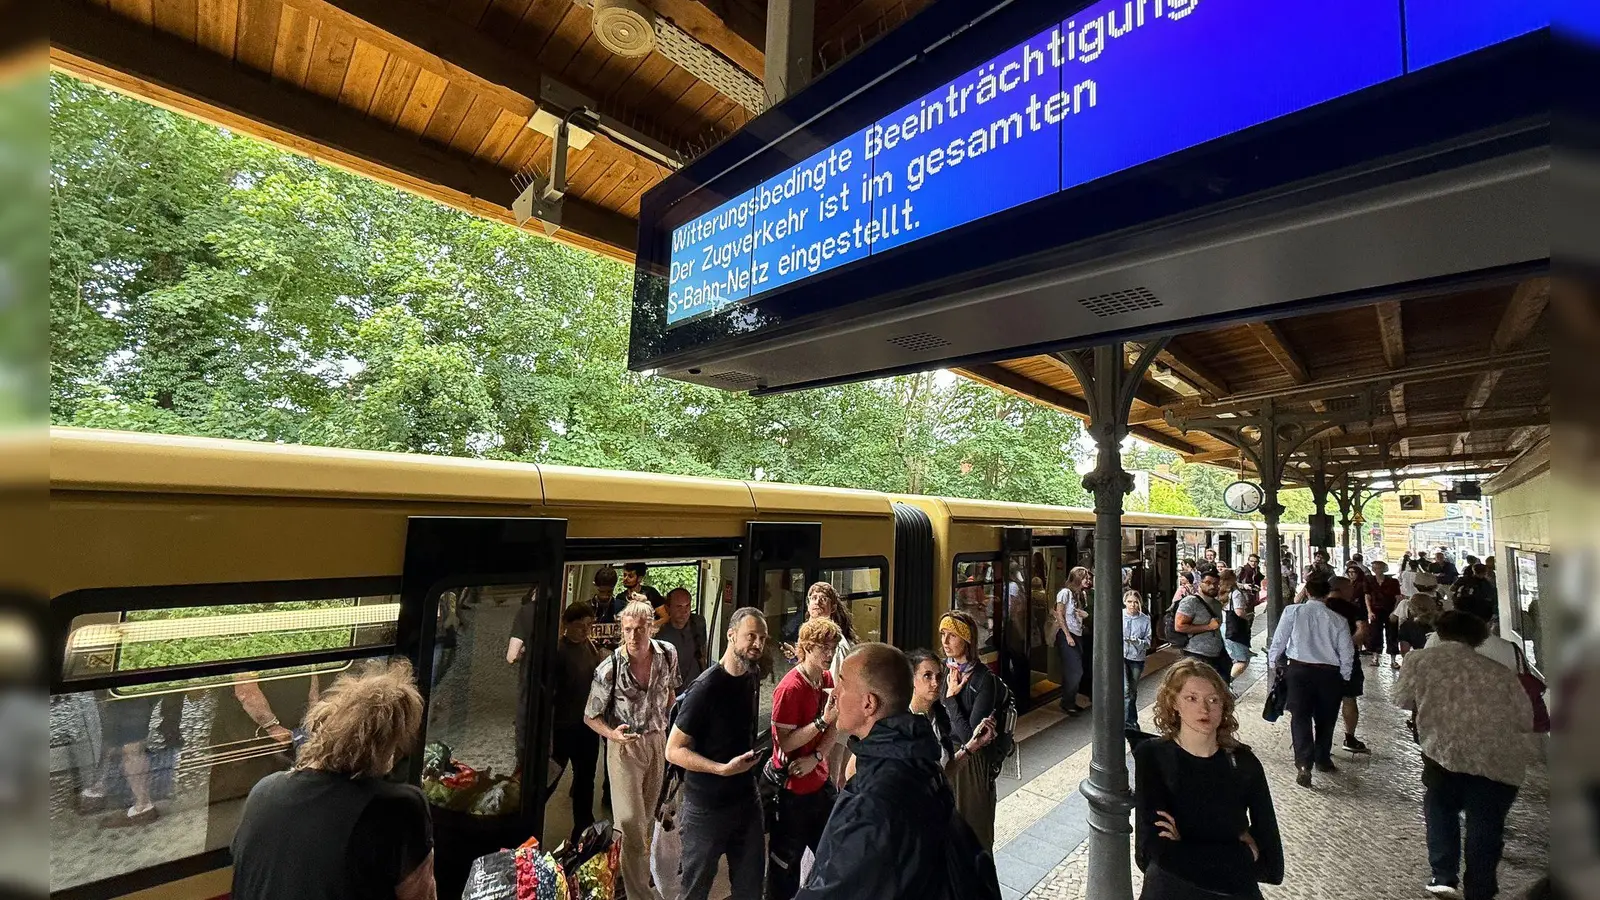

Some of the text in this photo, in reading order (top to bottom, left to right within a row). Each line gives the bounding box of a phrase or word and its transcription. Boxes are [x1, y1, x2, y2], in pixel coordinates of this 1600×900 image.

[668, 79, 1097, 285] Der Zugverkehr ist im gesamten
[672, 147, 853, 254] Witterungsbedingte
[668, 198, 920, 315] S-Bahn-Netz eingestellt.
[1402, 495, 1414, 508] 2
